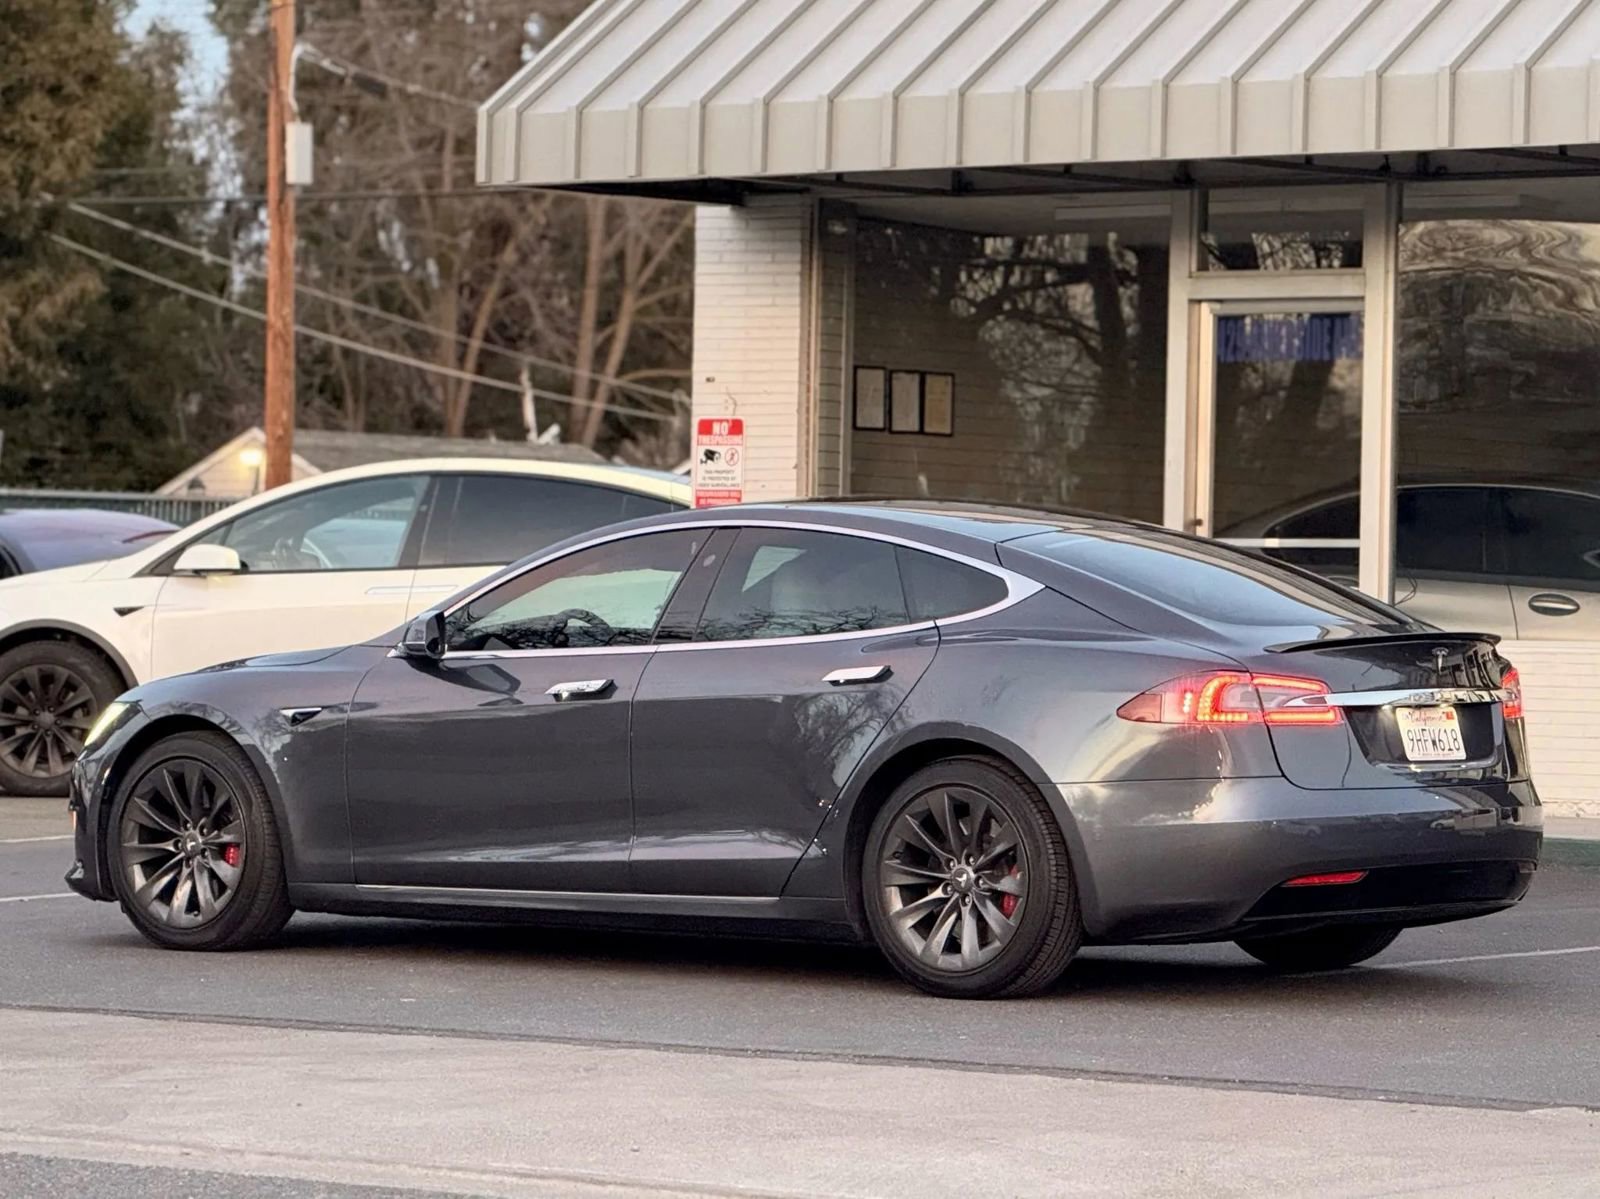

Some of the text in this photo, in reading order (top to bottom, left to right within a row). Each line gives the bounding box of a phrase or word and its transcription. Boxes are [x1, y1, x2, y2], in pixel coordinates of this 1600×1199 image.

[712, 421, 729, 435] NO
[1409, 709, 1443, 727] California
[1407, 728, 1461, 752] 9HFW618
